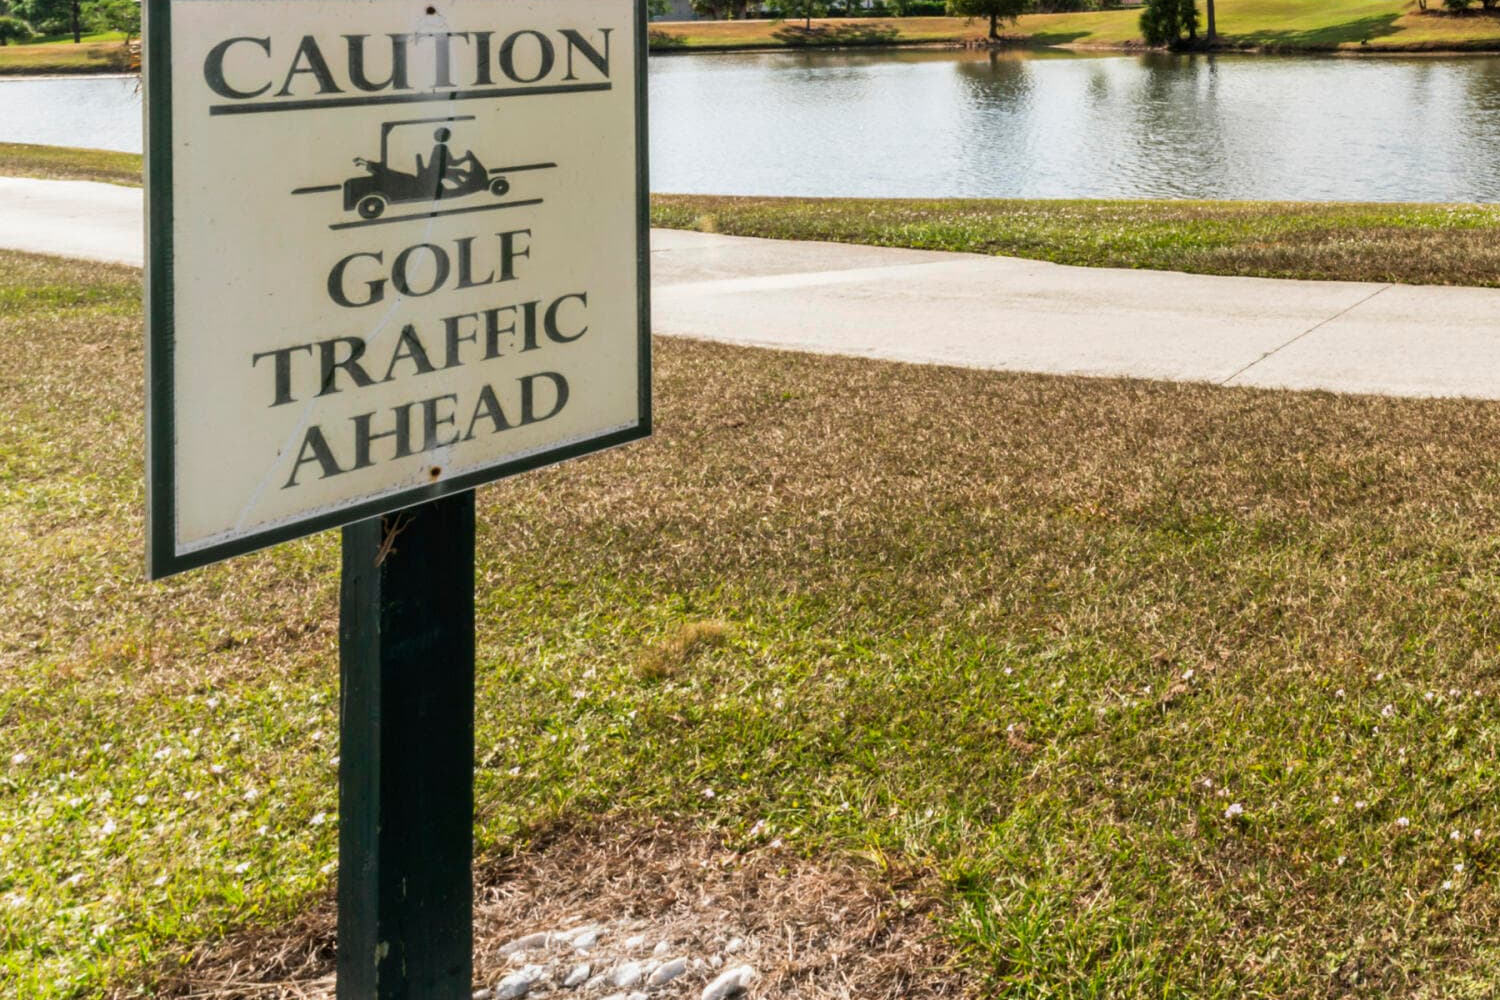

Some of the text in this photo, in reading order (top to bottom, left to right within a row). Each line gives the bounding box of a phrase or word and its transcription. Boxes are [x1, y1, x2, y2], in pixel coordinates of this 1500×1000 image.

[203, 27, 613, 99] CAUTION
[327, 228, 532, 308] GOLF
[252, 291, 588, 408] TRAFFIC
[280, 371, 570, 490] AHEAD
